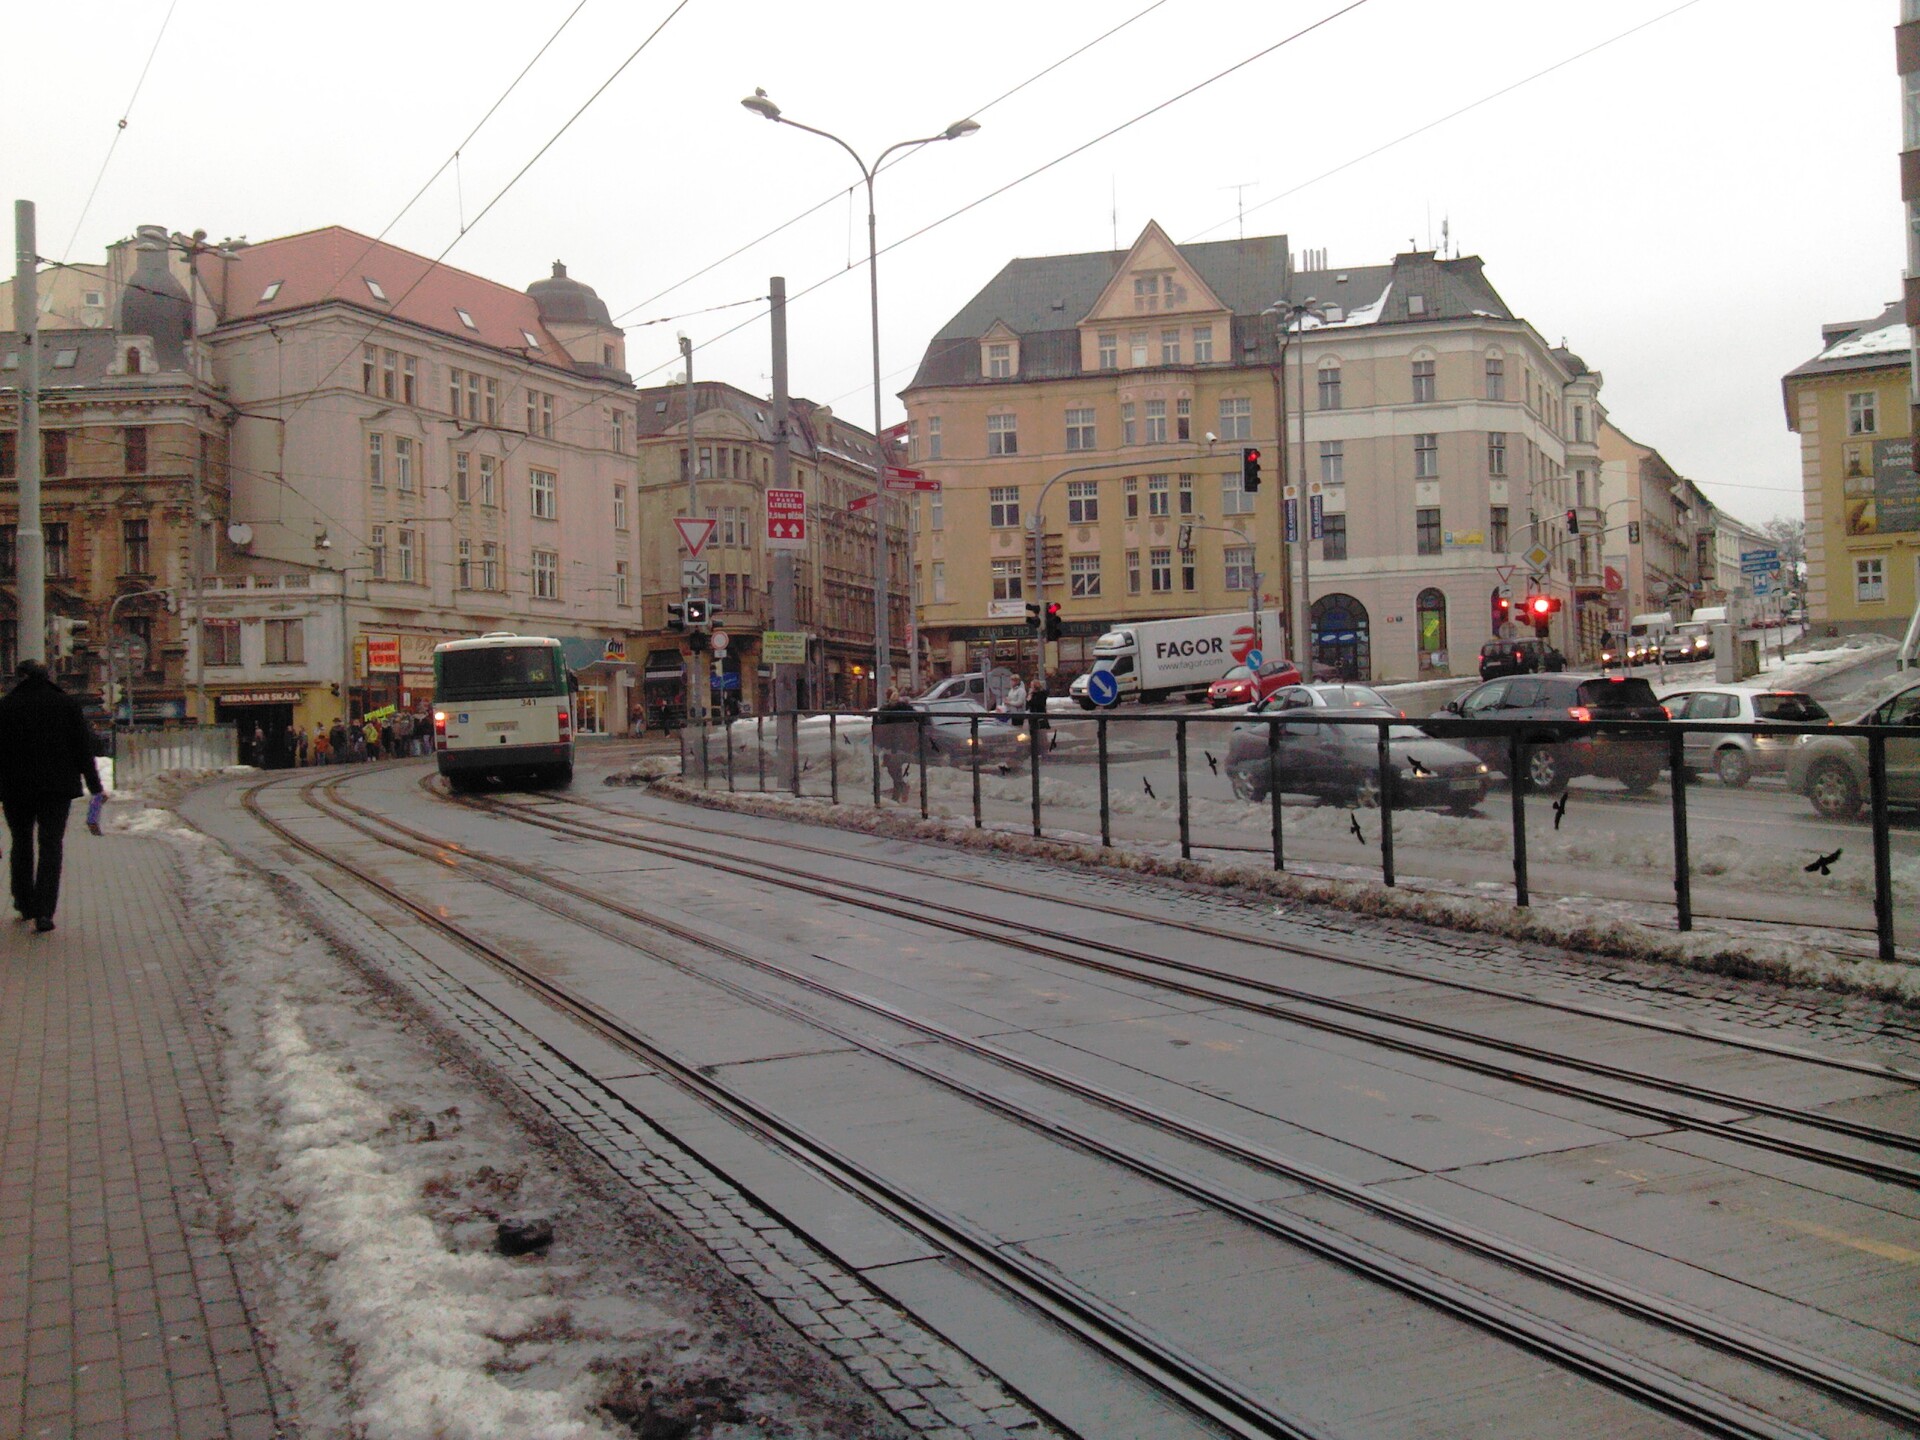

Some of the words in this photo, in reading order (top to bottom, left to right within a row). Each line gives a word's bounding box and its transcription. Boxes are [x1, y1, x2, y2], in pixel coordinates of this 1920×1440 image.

[608, 637, 624, 652] dm
[1156, 637, 1223, 659] FAGOR
[1158, 658, 1223, 671] www.fagor.com
[252, 693, 270, 701] BAR
[520, 698, 537, 707] 341
